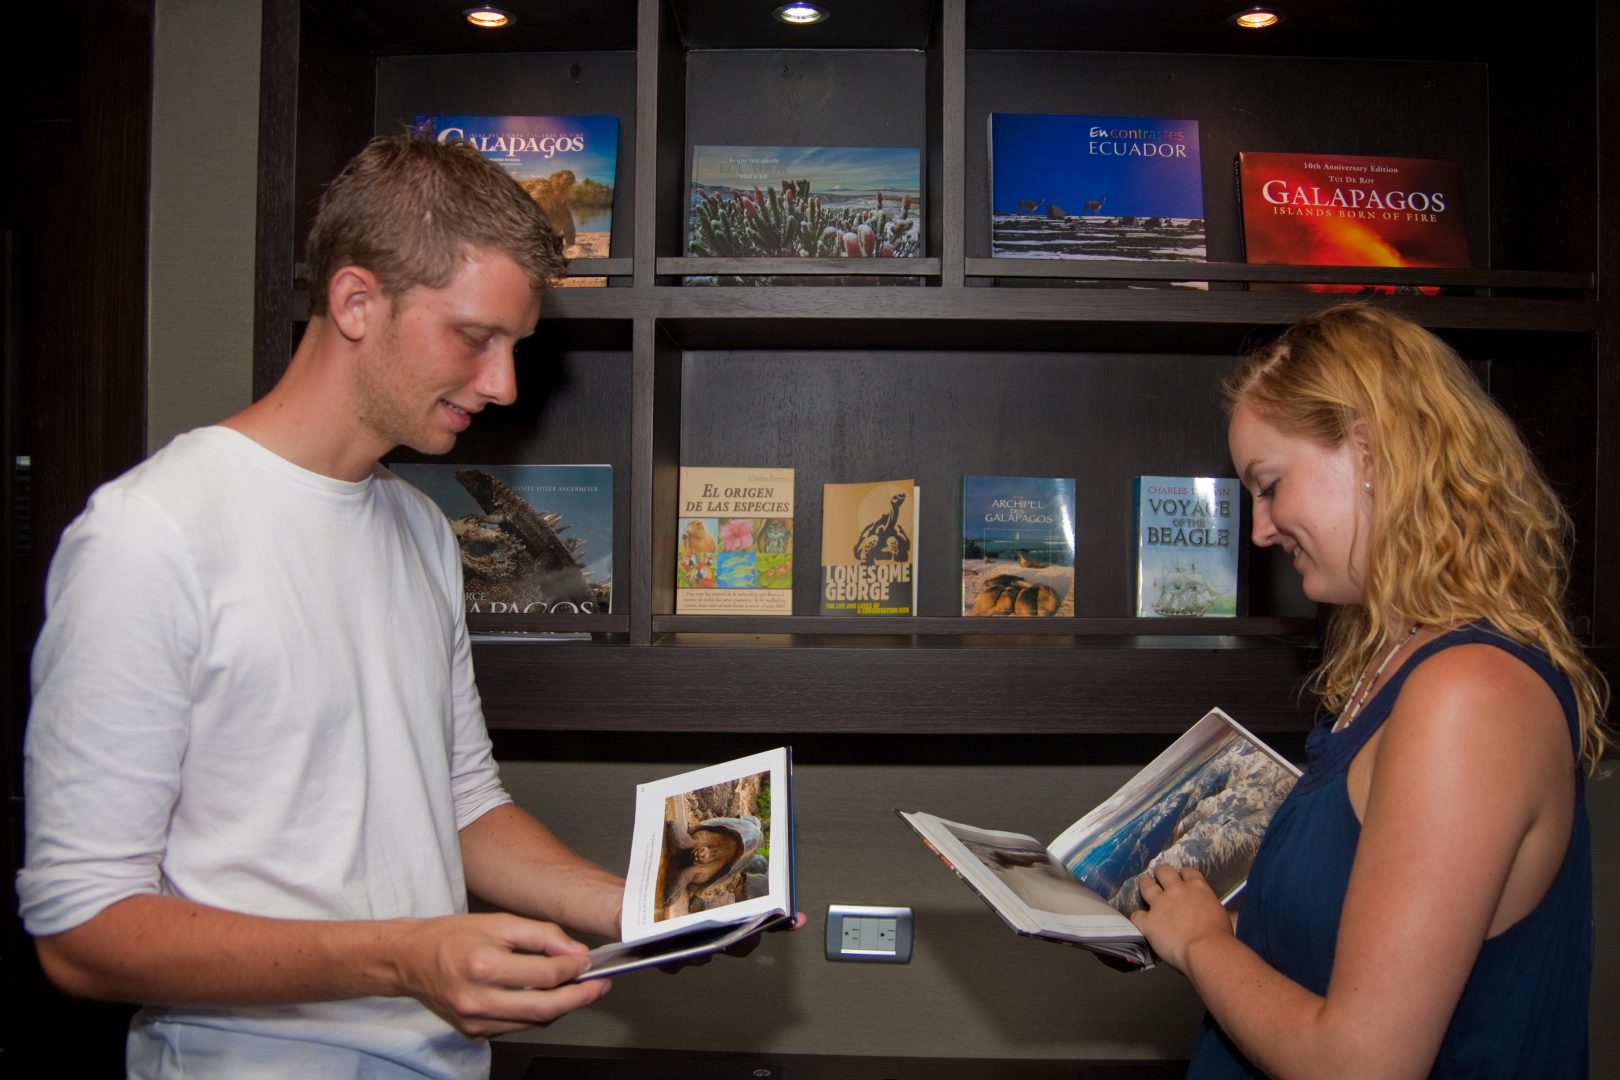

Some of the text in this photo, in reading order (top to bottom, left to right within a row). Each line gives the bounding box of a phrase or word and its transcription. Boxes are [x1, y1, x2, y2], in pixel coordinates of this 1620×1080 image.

[437, 127, 584, 159] GALAPAGOS
[1089, 141, 1187, 158] ECUADOR
[1303, 162, 1399, 173] 10th Anniversary Edition
[1262, 179, 1446, 213] GALAPAGOS
[1273, 206, 1437, 223] ISLANDS BORN OF FIRE
[724, 487, 774, 498] ORIGEN
[1148, 486, 1188, 497] CHARLES
[685, 501, 790, 513] DE LAS ESPECIES
[991, 499, 1044, 509] ARCHIPEL
[984, 513, 1054, 524] GALAPAGOS
[1172, 518, 1206, 528] OF THE
[1147, 526, 1230, 547] BEAGLE
[825, 564, 911, 584] LONESOME
[464, 591, 487, 601] RCE
[825, 581, 890, 601] GEORGE
